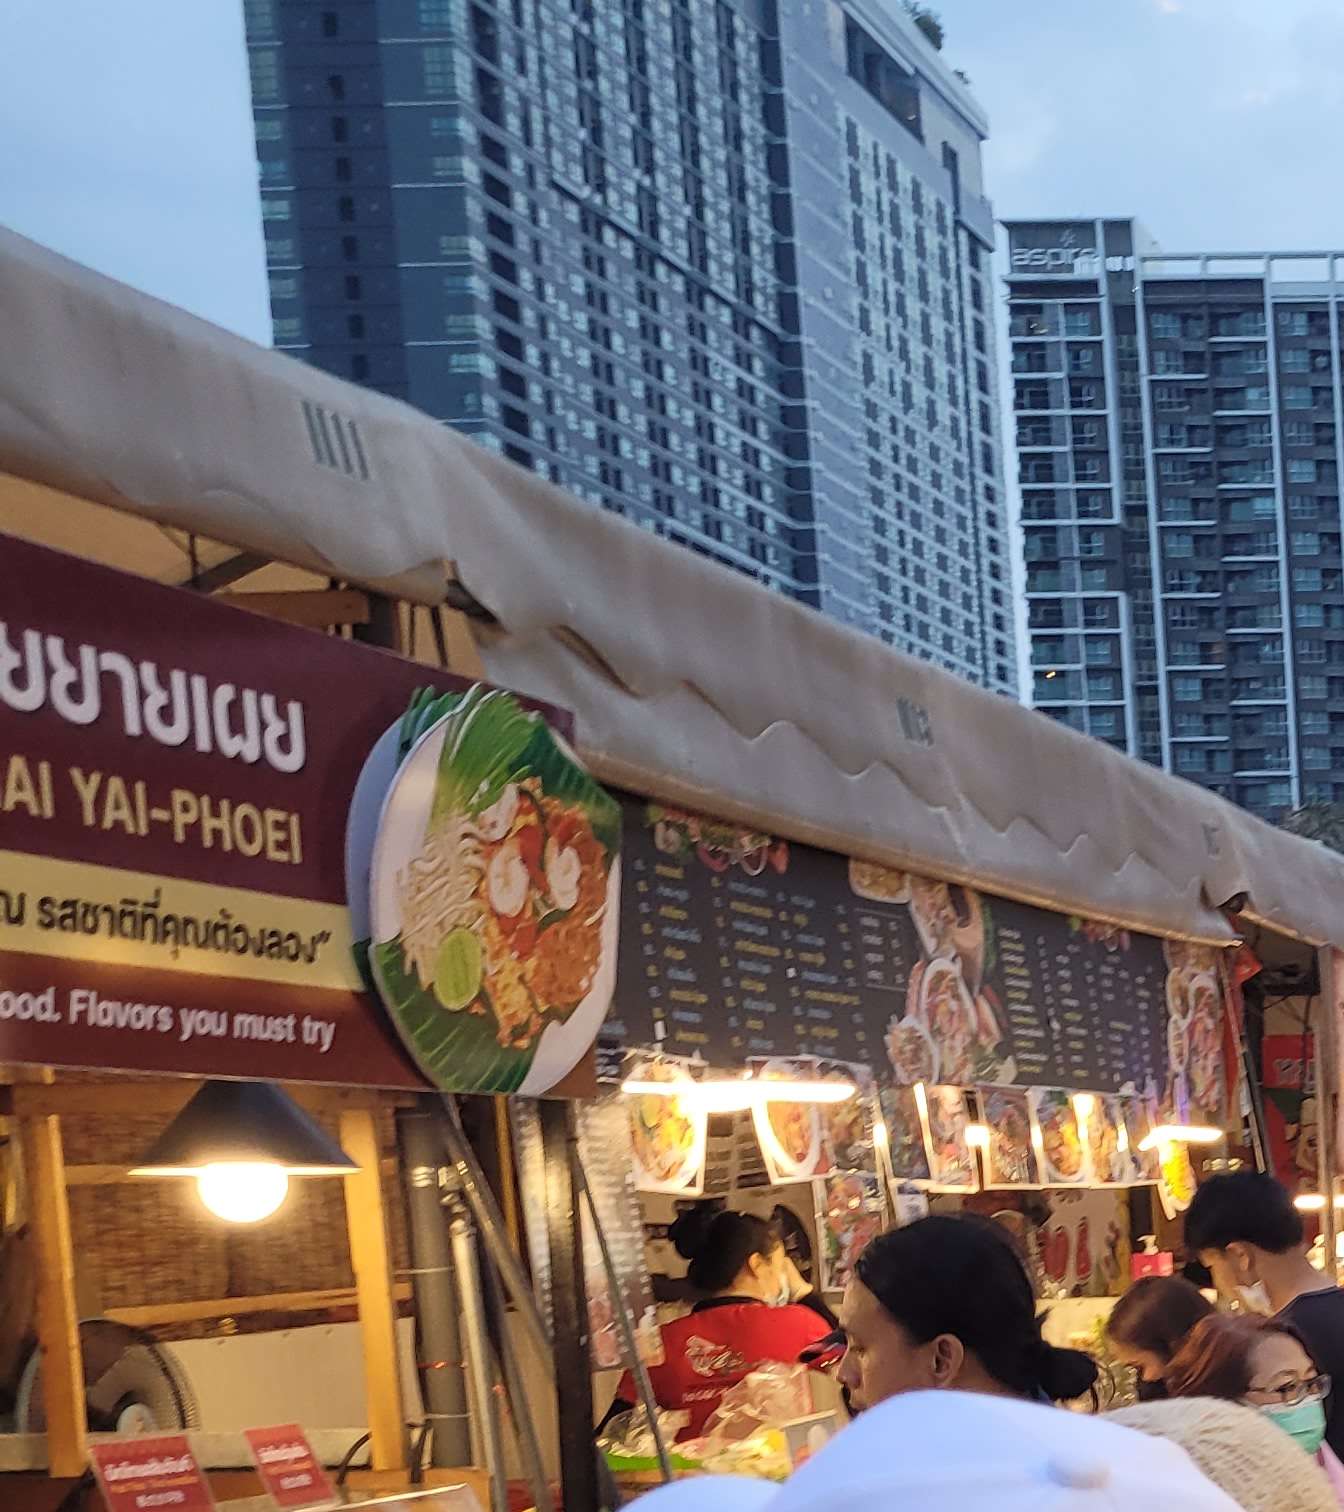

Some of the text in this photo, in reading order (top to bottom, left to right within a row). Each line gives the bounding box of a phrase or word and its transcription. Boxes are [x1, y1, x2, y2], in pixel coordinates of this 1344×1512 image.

[69, 765, 303, 865] YAI-PHOEI
[69, 987, 174, 1034] Flavors
[178, 1006, 229, 1042] you
[233, 1012, 298, 1044] must
[301, 1014, 336, 1053] try
